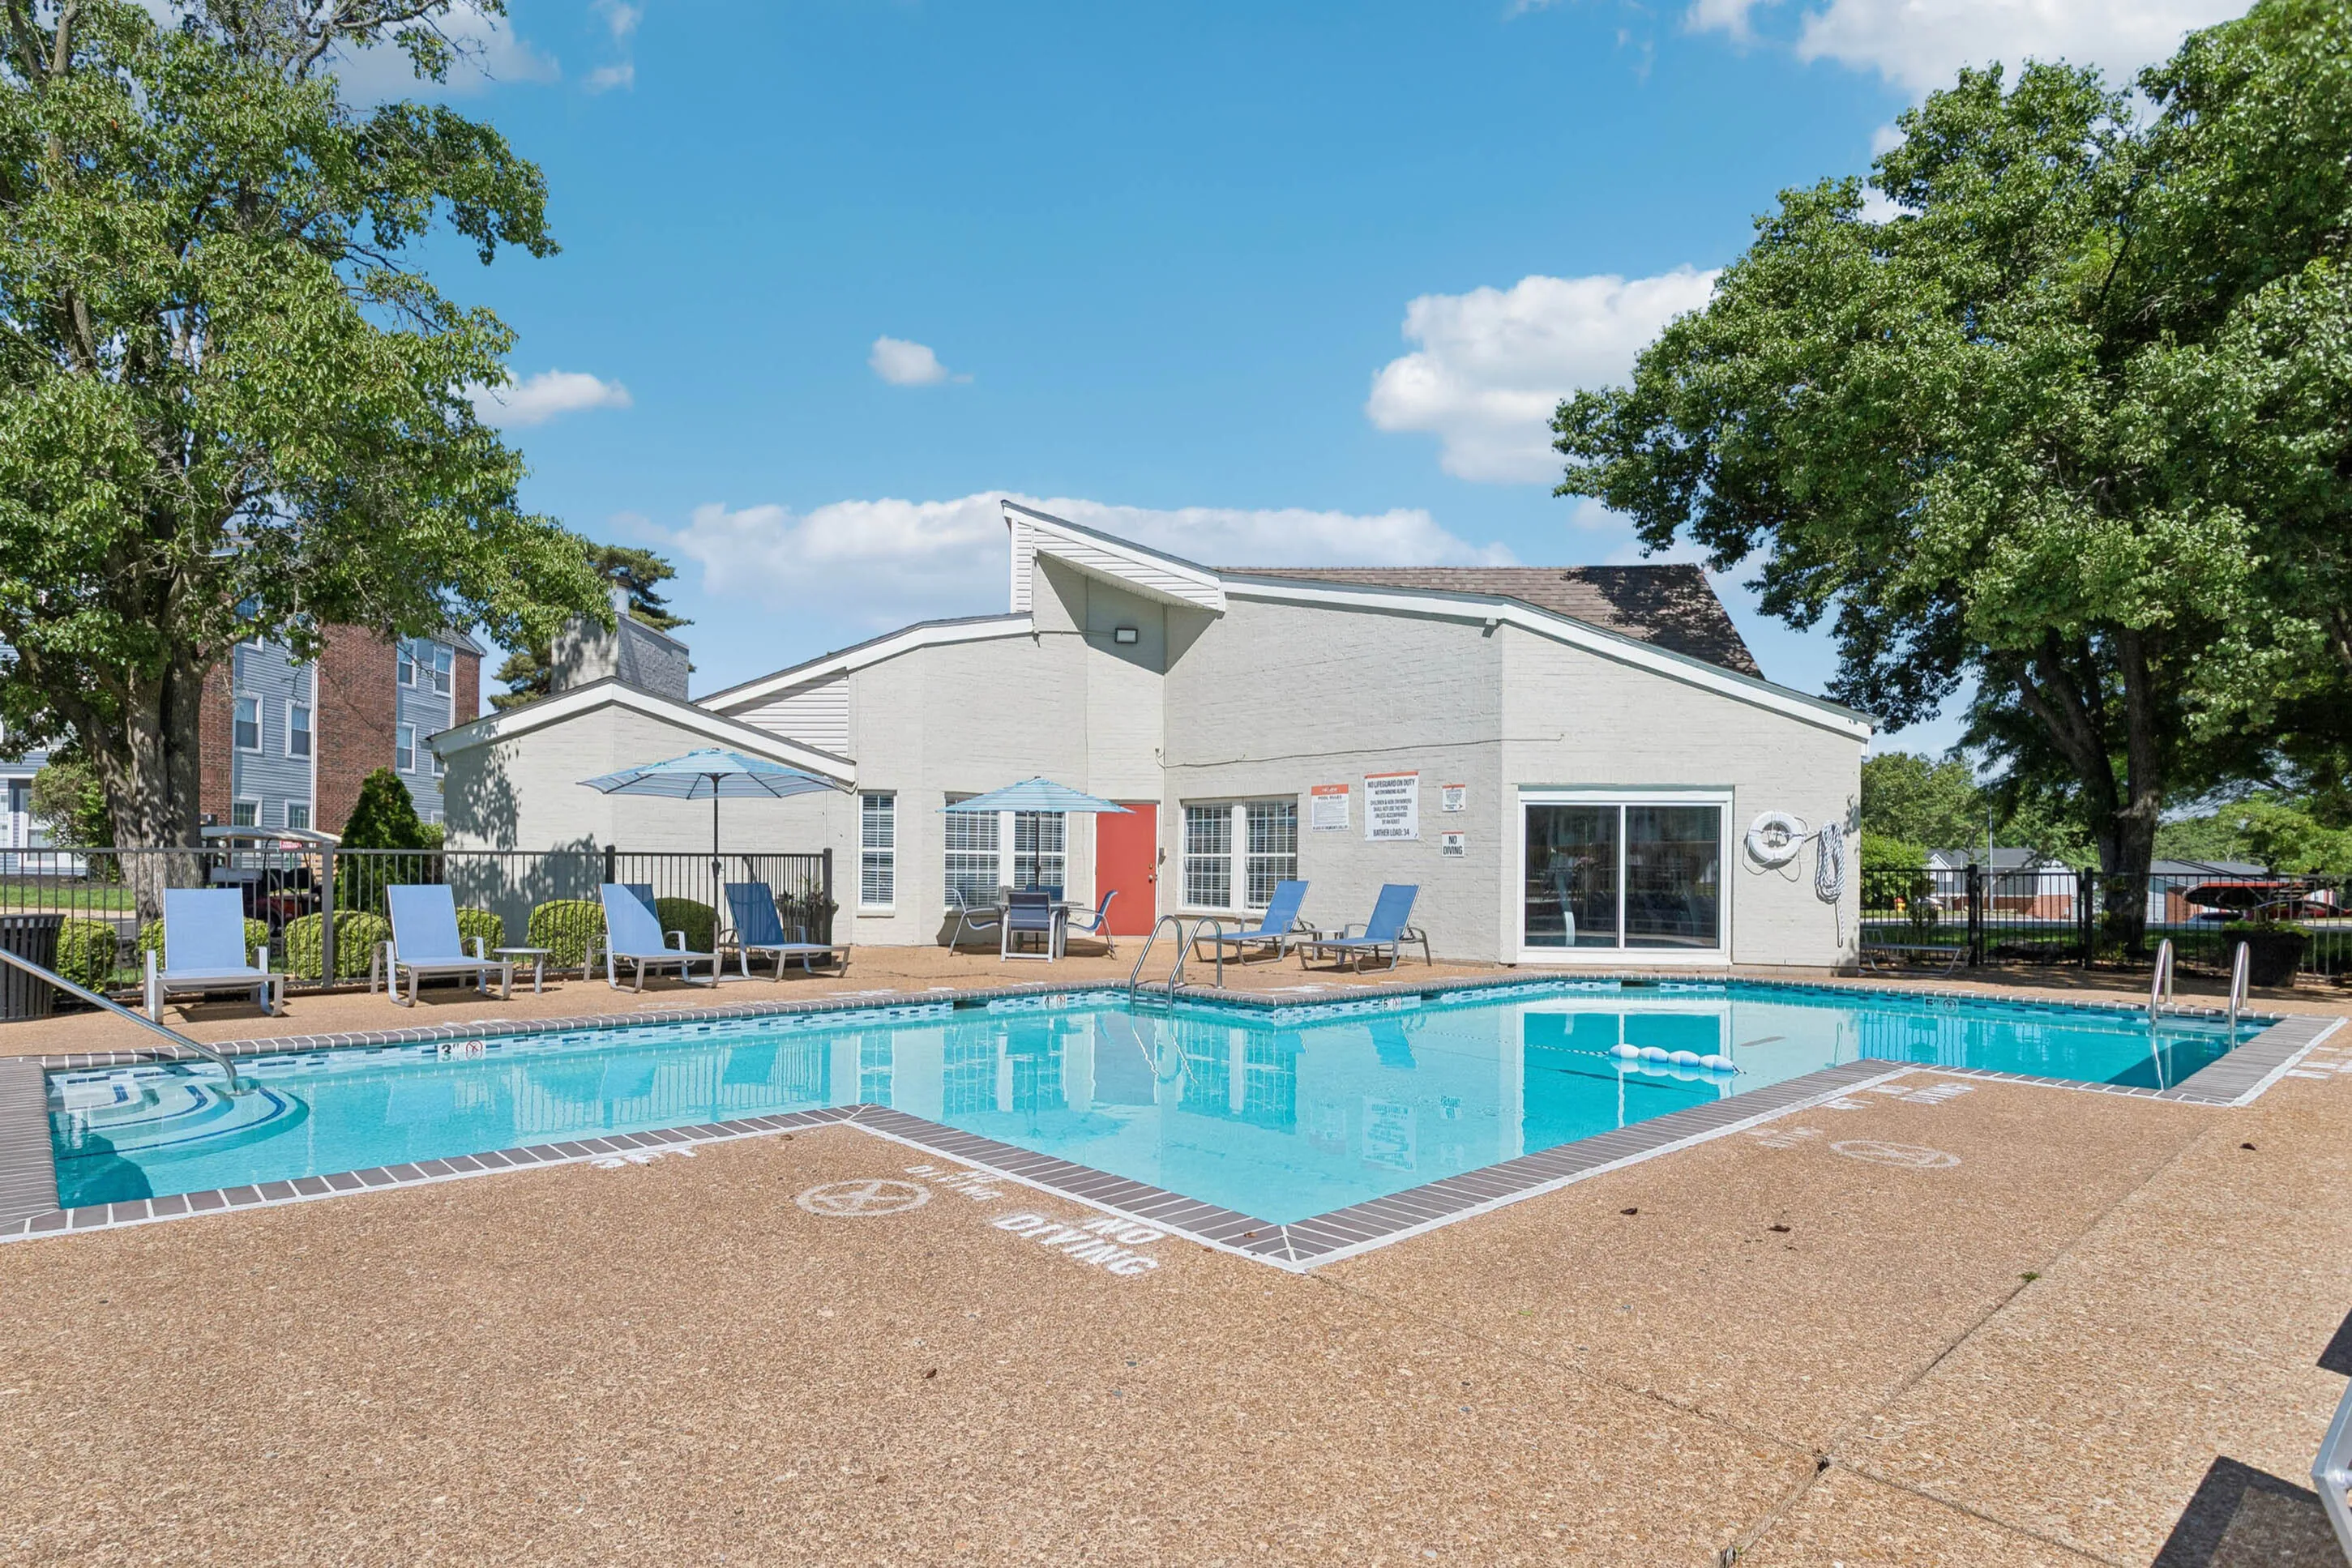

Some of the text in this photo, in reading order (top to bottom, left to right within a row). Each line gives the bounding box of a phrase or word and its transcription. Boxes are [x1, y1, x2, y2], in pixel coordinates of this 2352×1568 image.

[1374, 780, 1396, 788] LIFEGUARD
[1396, 779, 1403, 787] ON
[1404, 778, 1415, 786] DUTY
[1373, 827, 1409, 836] BATHER LOAD: 34
[1448, 835, 1457, 844] NO
[1443, 845, 1463, 856] DIVING
[904, 1165, 1004, 1201] DIVING
[1081, 1217, 1165, 1245] NO
[992, 1214, 1159, 1275] DIVING
